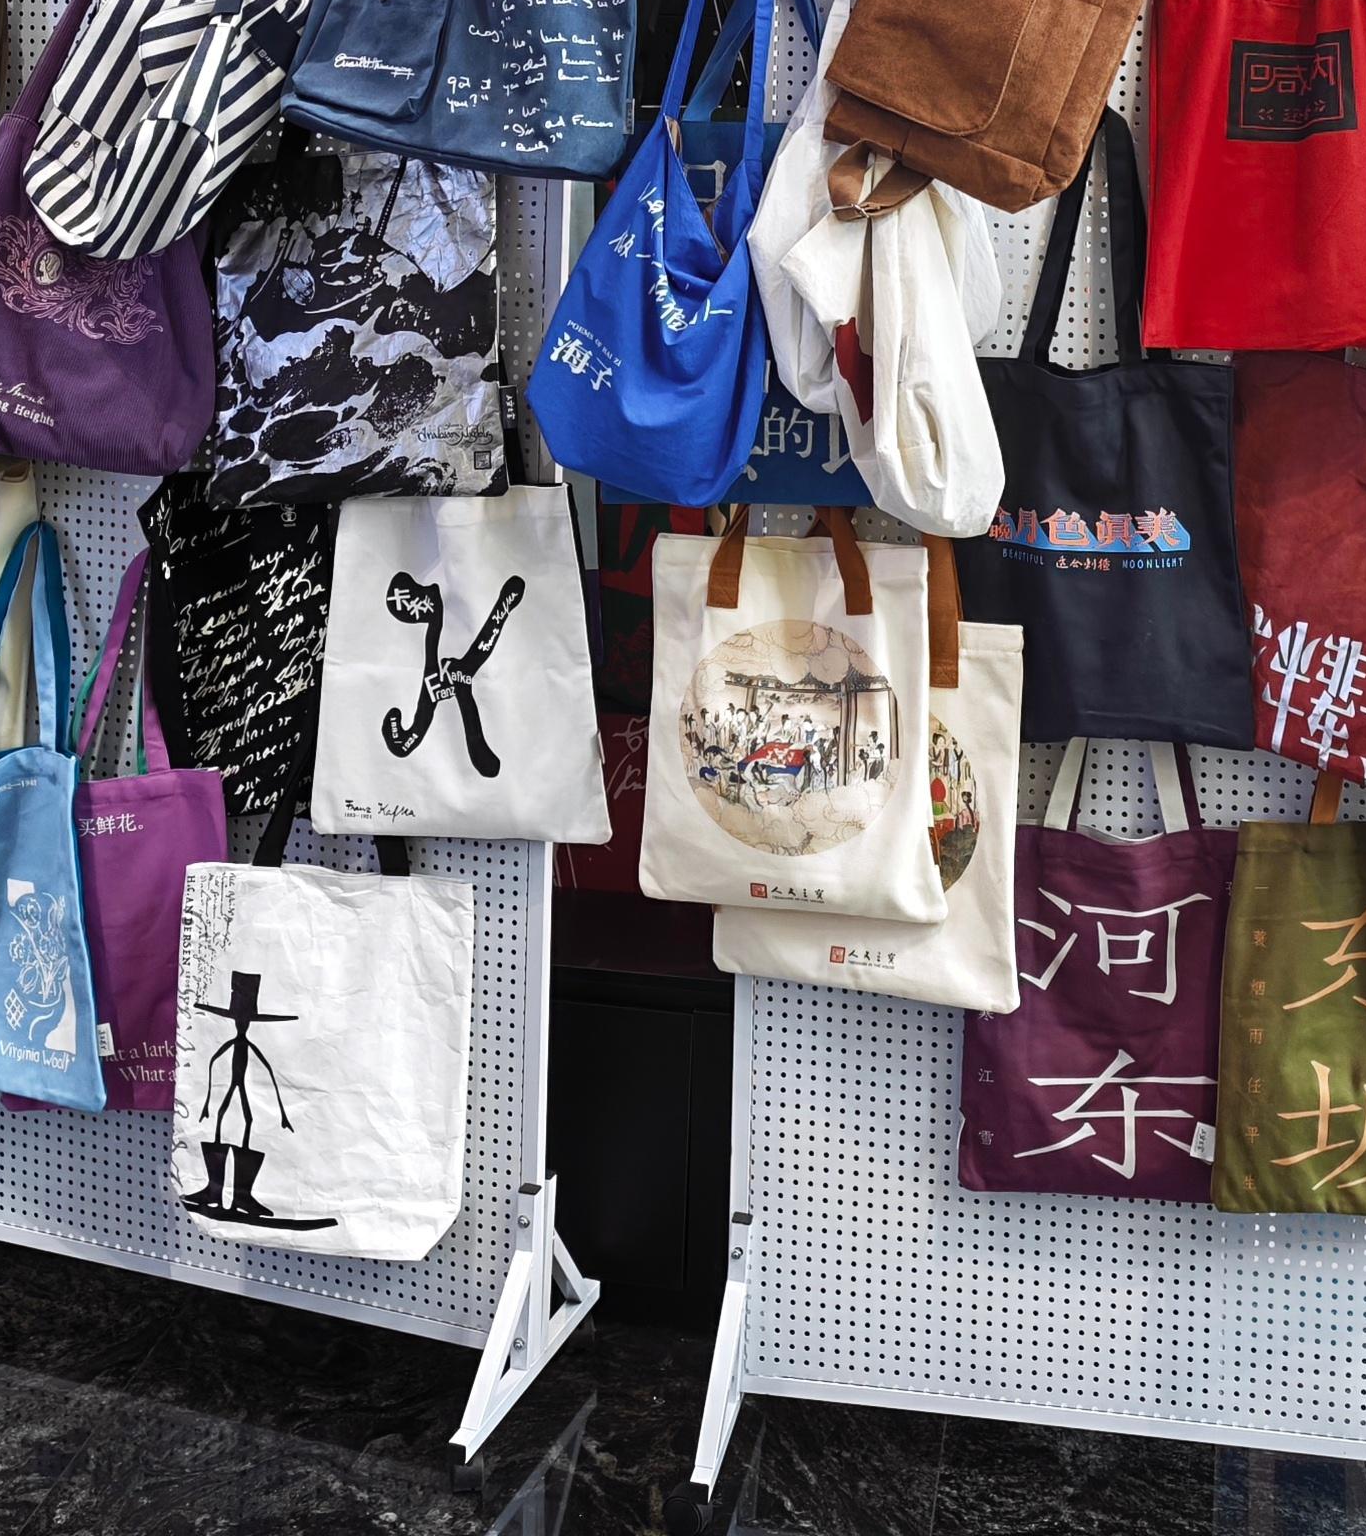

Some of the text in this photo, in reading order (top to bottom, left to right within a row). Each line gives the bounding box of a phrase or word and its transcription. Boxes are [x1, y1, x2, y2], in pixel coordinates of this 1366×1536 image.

[550, 331, 613, 391] 海子
[14, 404, 55, 427] Heights
[1002, 548, 1044, 565] BEAUTIFUL
[440, 660, 473, 685] Kafka
[425, 672, 456, 703] Franz
[1013, 886, 1219, 1180] 河东
[0, 1040, 70, 1073] Virginia Woolf
[143, 1041, 175, 1058] lark
[119, 1064, 165, 1082] What
